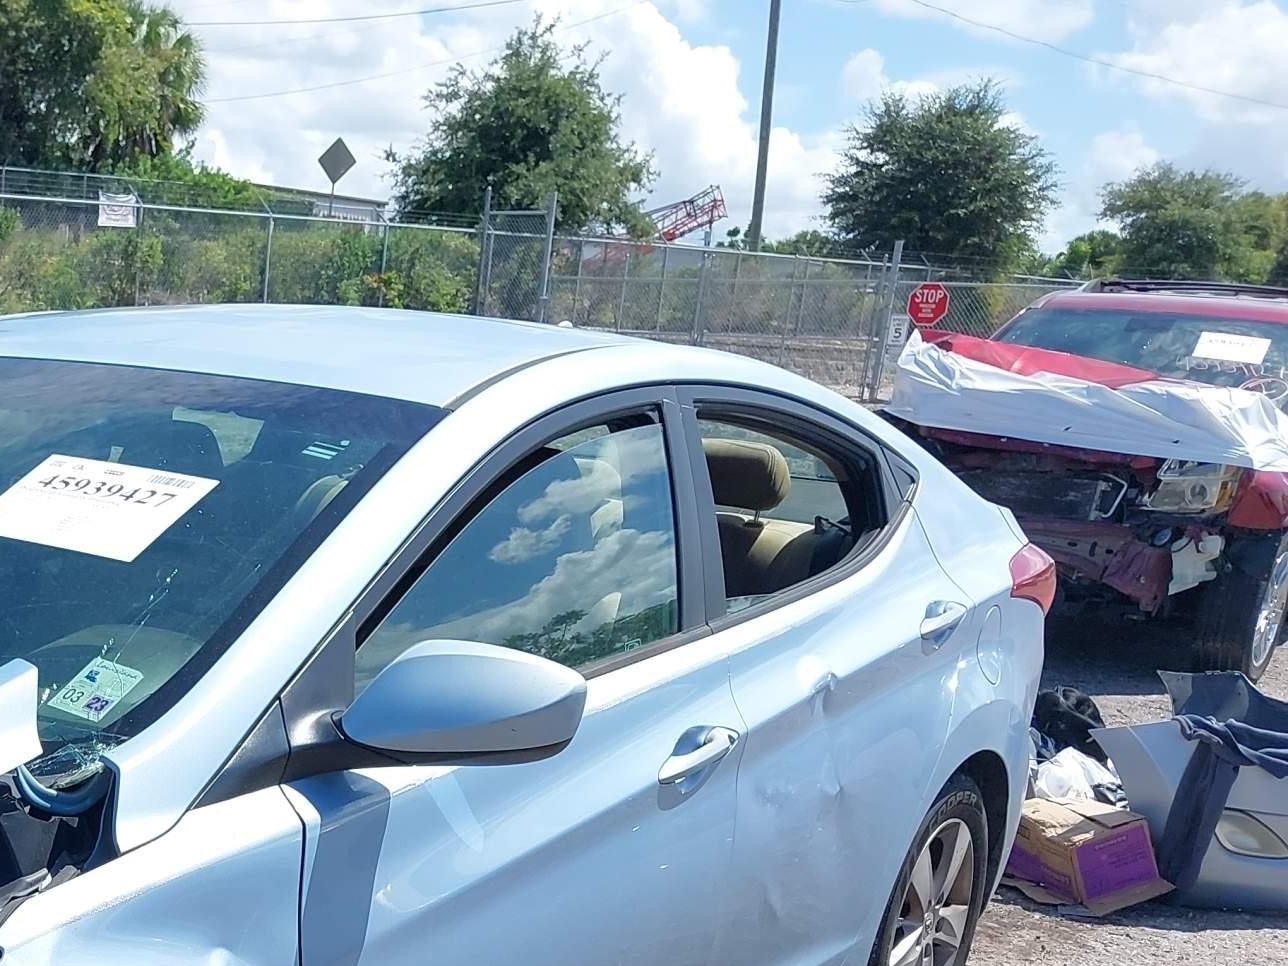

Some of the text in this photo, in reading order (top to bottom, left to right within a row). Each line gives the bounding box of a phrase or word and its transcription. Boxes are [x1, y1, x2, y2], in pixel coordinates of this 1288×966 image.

[914, 288, 945, 303] STOP
[893, 327, 902, 339] 5
[38, 474, 178, 507] 45939427
[62, 688, 85, 703] 03
[86, 696, 109, 712] 23
